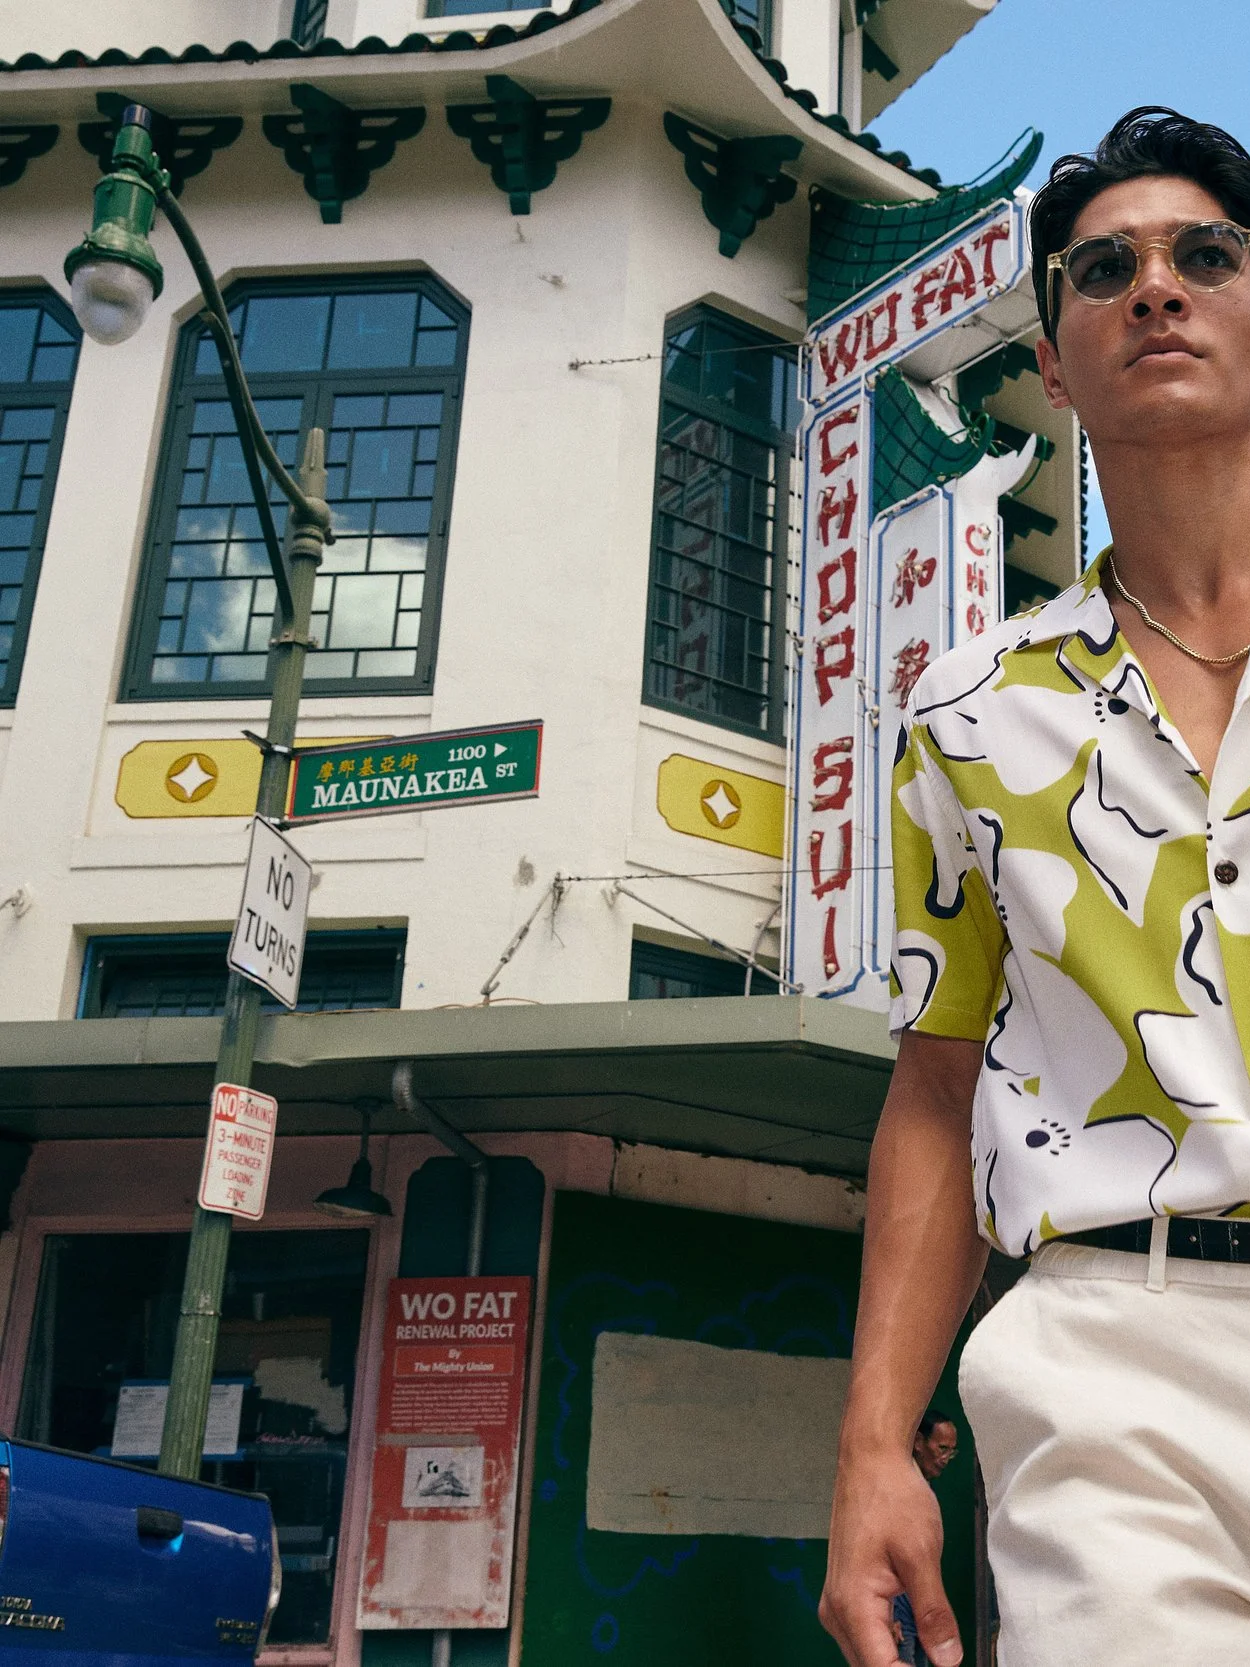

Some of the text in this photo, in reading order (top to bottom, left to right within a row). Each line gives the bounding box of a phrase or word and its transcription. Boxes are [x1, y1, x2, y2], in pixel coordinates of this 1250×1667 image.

[818, 220, 1010, 387] WO FAT
[808, 404, 859, 981] CHOP SUI
[447, 744, 487, 763] 1100
[311, 762, 518, 809] MAUNAKEA ST
[266, 855, 295, 911] NO
[244, 907, 296, 979] TURNS
[216, 1091, 274, 1125] NO PARKING
[218, 1128, 266, 1154] 3-MINUTE
[217, 1149, 262, 1170] PASSENGER
[222, 1168, 254, 1186] LOADING
[226, 1187, 246, 1203] ZONE
[401, 1291, 518, 1321] WO FAT
[396, 1323, 516, 1339] RENEWAL PROJECT
[448, 1348, 462, 1359] By
[414, 1361, 495, 1374] The Mighty Union
